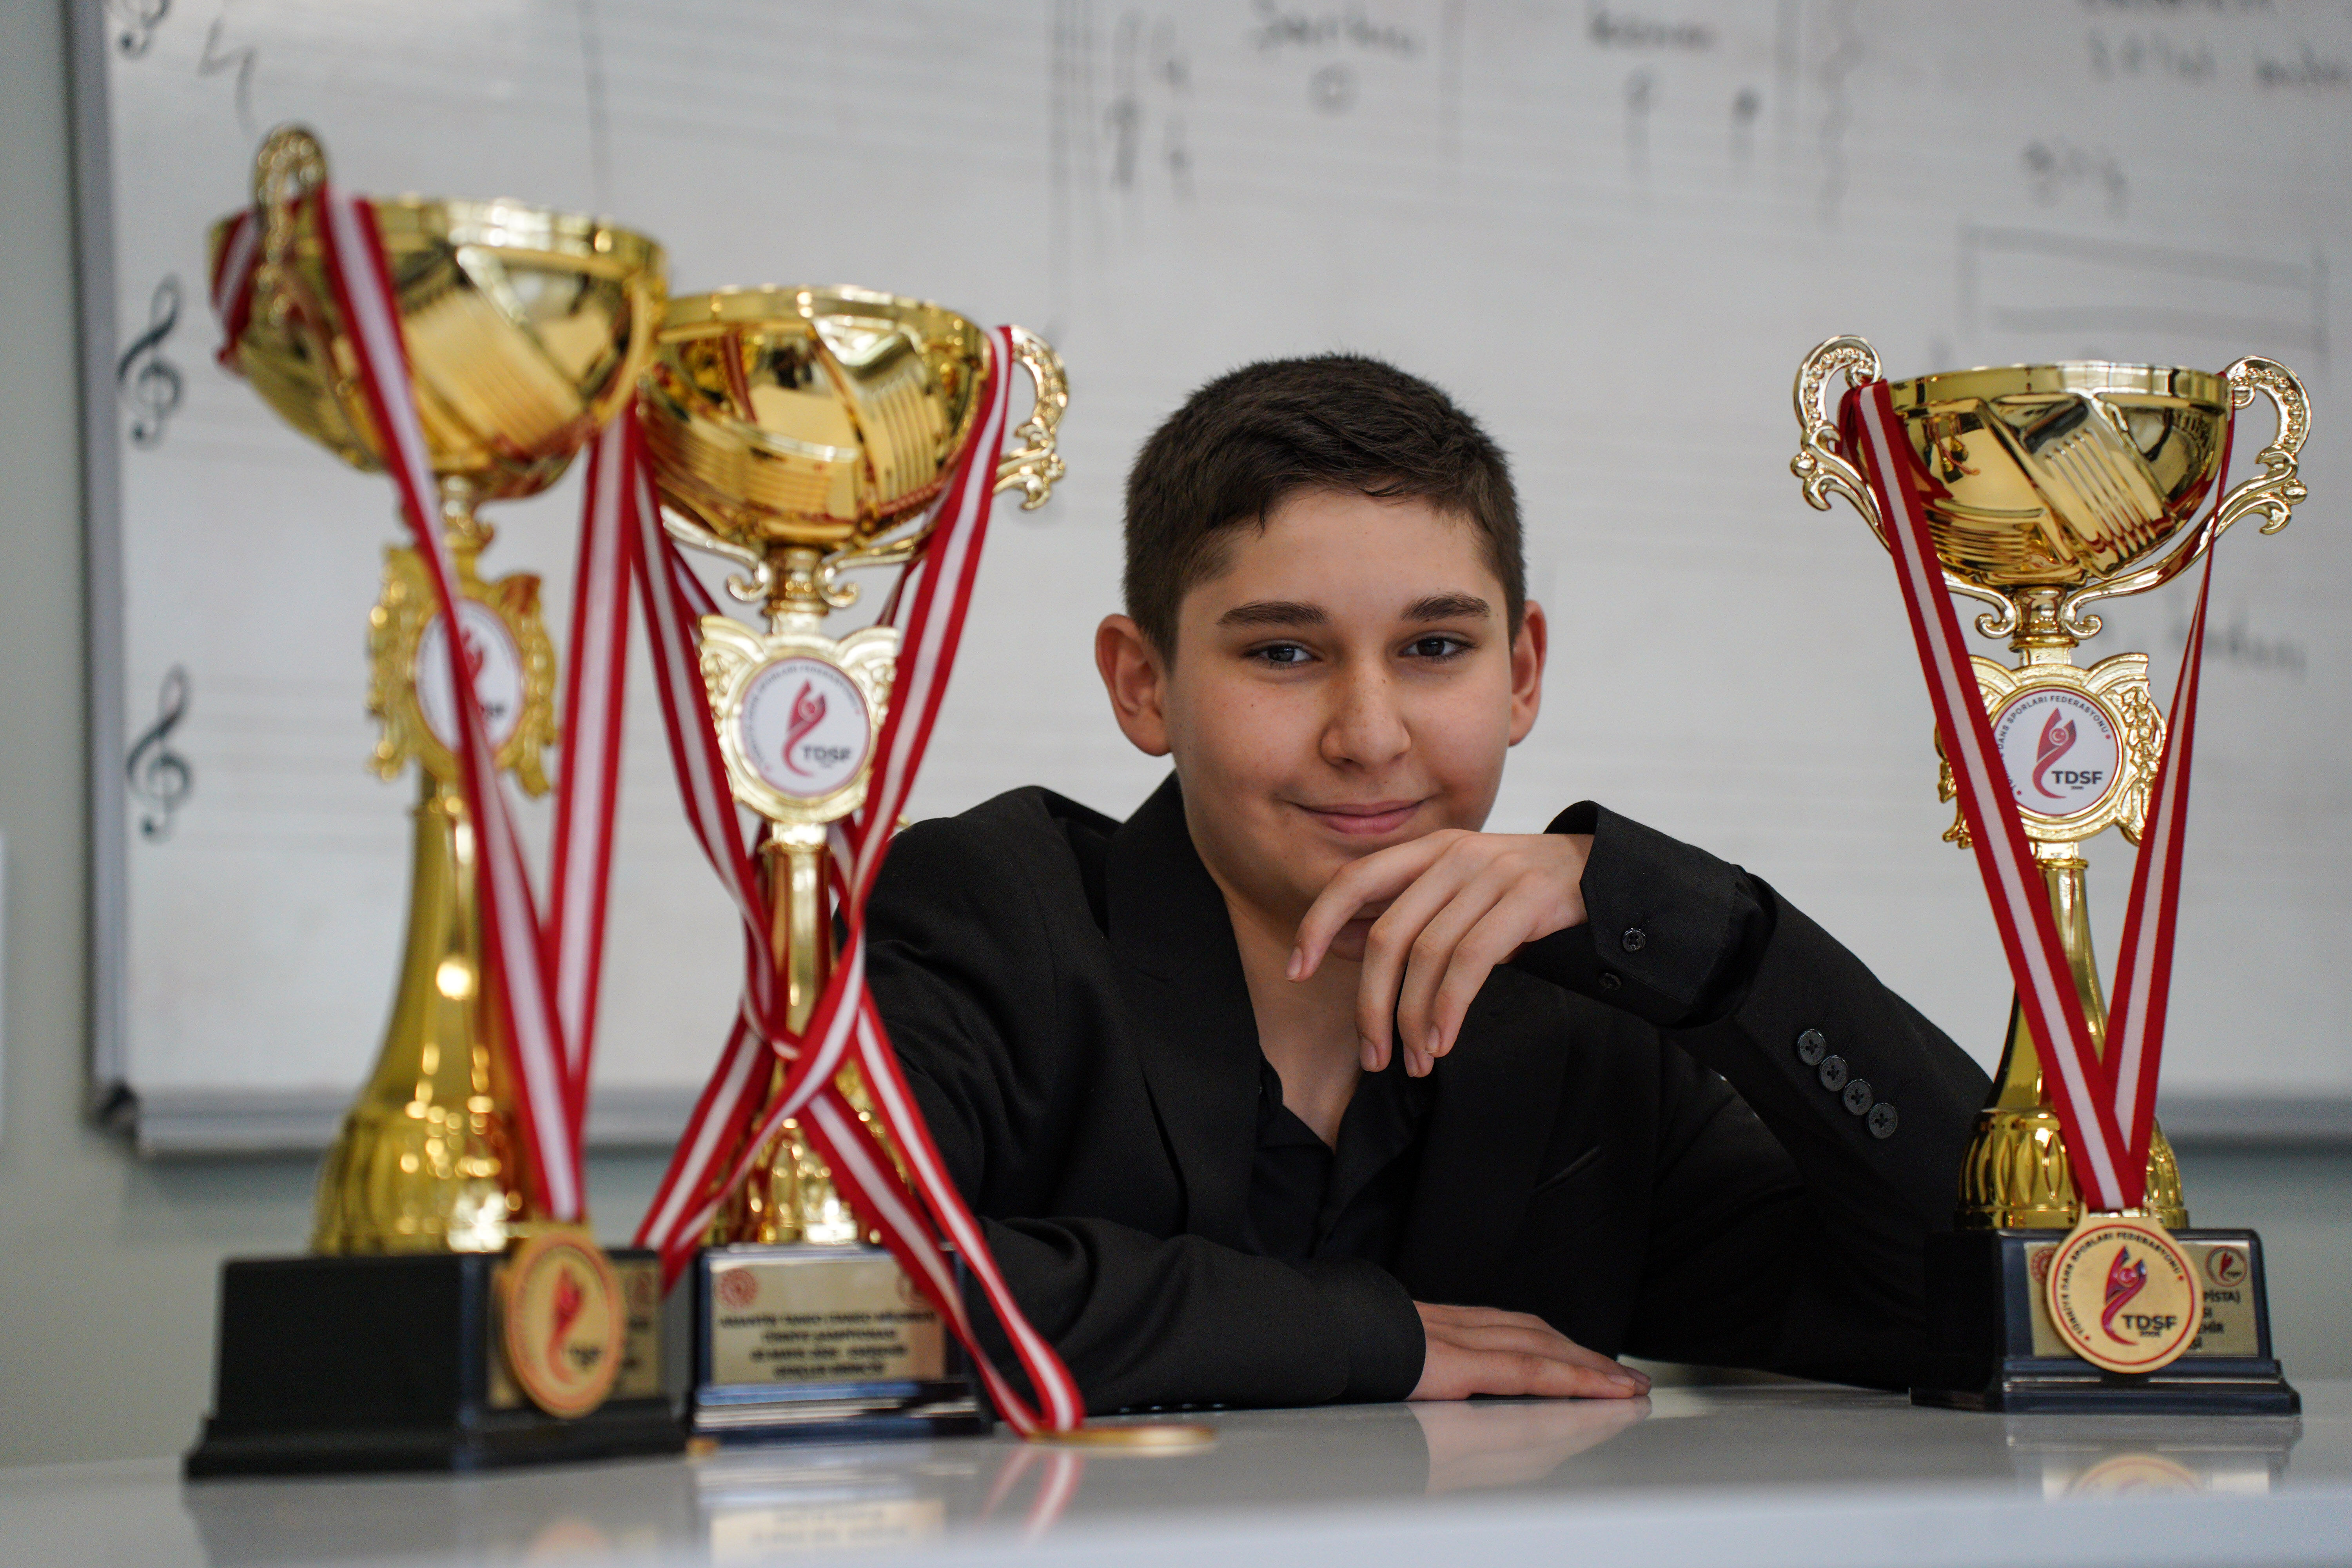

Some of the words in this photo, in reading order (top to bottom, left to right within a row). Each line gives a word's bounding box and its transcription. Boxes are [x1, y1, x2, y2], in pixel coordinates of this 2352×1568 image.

[2007, 696, 2047, 724] SPORLARI
[2050, 695, 2109, 733] FEDERASYONU
[2051, 771, 2103, 784] TDSF
[2121, 1314, 2176, 1330] TDSF
